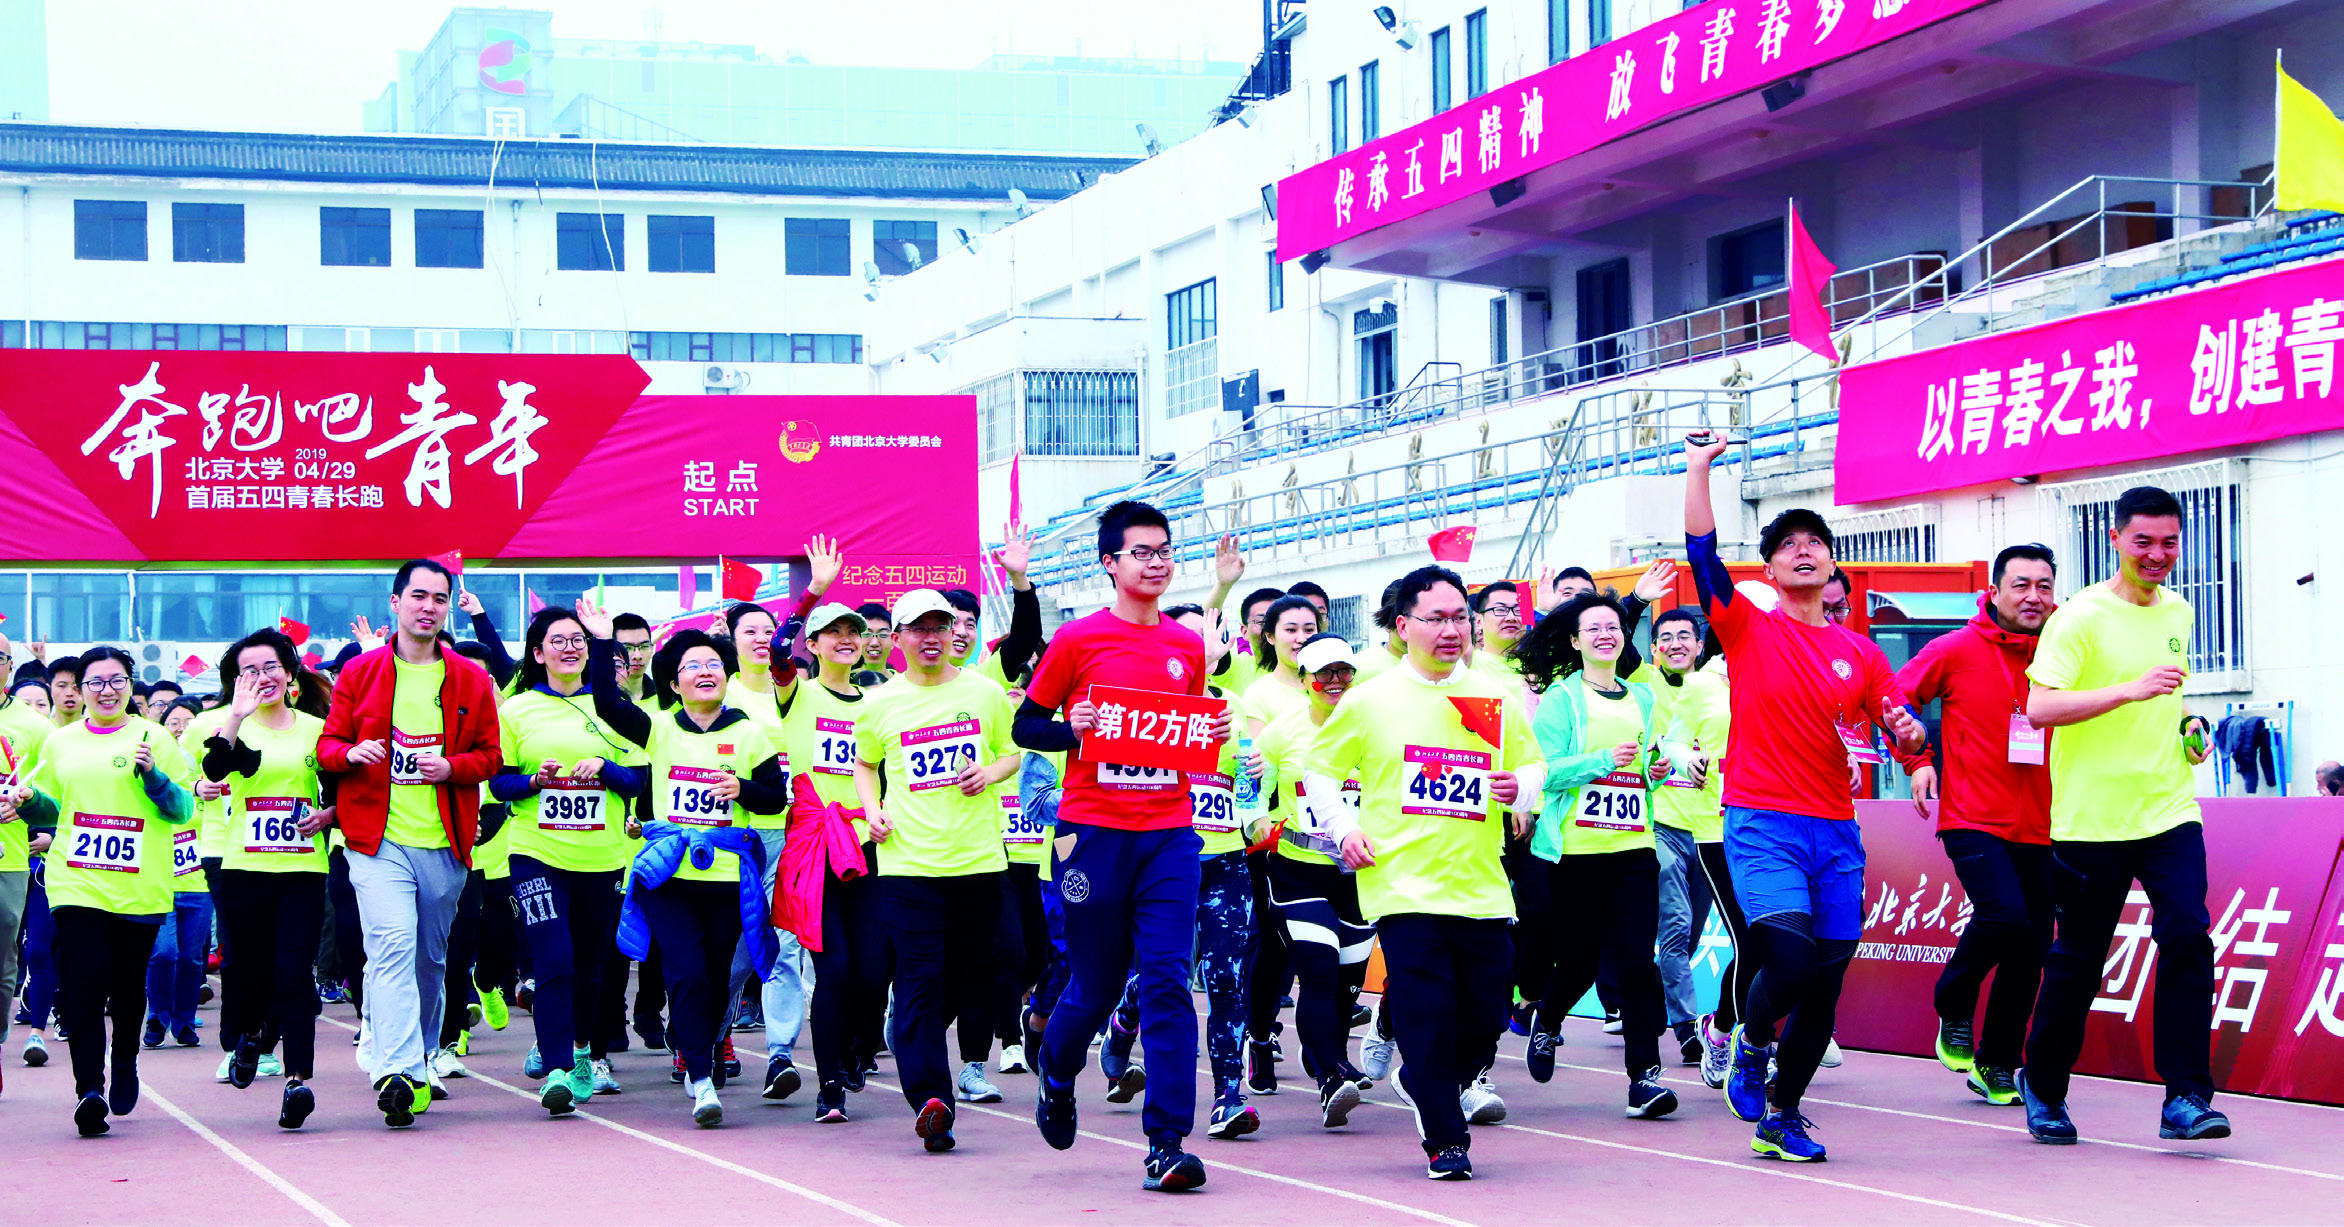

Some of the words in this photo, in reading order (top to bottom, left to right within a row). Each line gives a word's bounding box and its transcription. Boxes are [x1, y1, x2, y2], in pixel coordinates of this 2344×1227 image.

[1333, 86, 1544, 228] 传承五四精神
[2189, 298, 2344, 416] 创建青
[81, 361, 549, 519] 奔跑吧青年
[829, 435, 942, 448] 共青团北京大学委员会
[295, 448, 327, 460] 2019
[185, 456, 285, 481] 北京大学
[294, 461, 356, 480] 04/29
[683, 460, 759, 493] 起点
[185, 484, 385, 509] 首届五四青春长跑
[683, 498, 760, 517] START
[842, 564, 967, 586] 纪念五四运动
[1094, 701, 1217, 750] 第12方阵
[910, 743, 977, 778] 3279
[673, 786, 730, 815] 1394
[1409, 770, 1482, 806] 4624
[544, 795, 601, 820] 3987
[1584, 790, 1641, 820] 2130
[251, 817, 305, 842] 166
[74, 832, 136, 862] 2105
[1854, 941, 1896, 961] PEKING
[1895, 944, 1957, 965] UNIVERSIT
